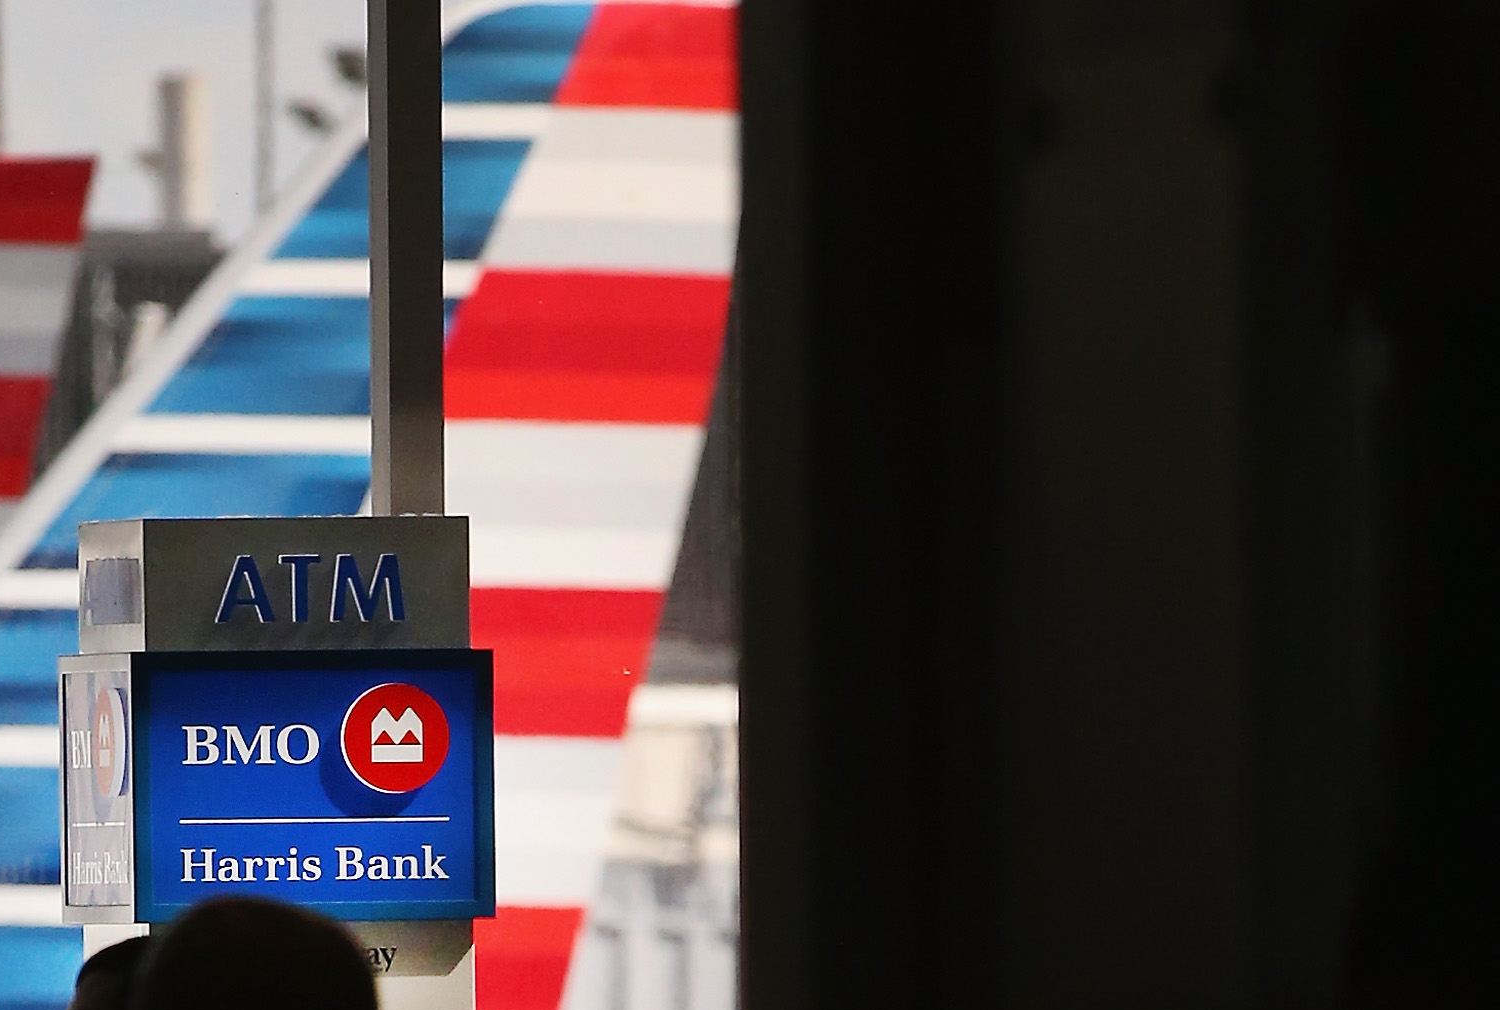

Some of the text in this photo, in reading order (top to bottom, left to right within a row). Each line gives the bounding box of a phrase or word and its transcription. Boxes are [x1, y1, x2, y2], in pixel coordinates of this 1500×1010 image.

[215, 553, 406, 623] ATM
[70, 729, 93, 769] BM
[181, 724, 320, 765] BMO
[72, 851, 102, 885] Harris
[180, 843, 450, 882] Harris Bank
